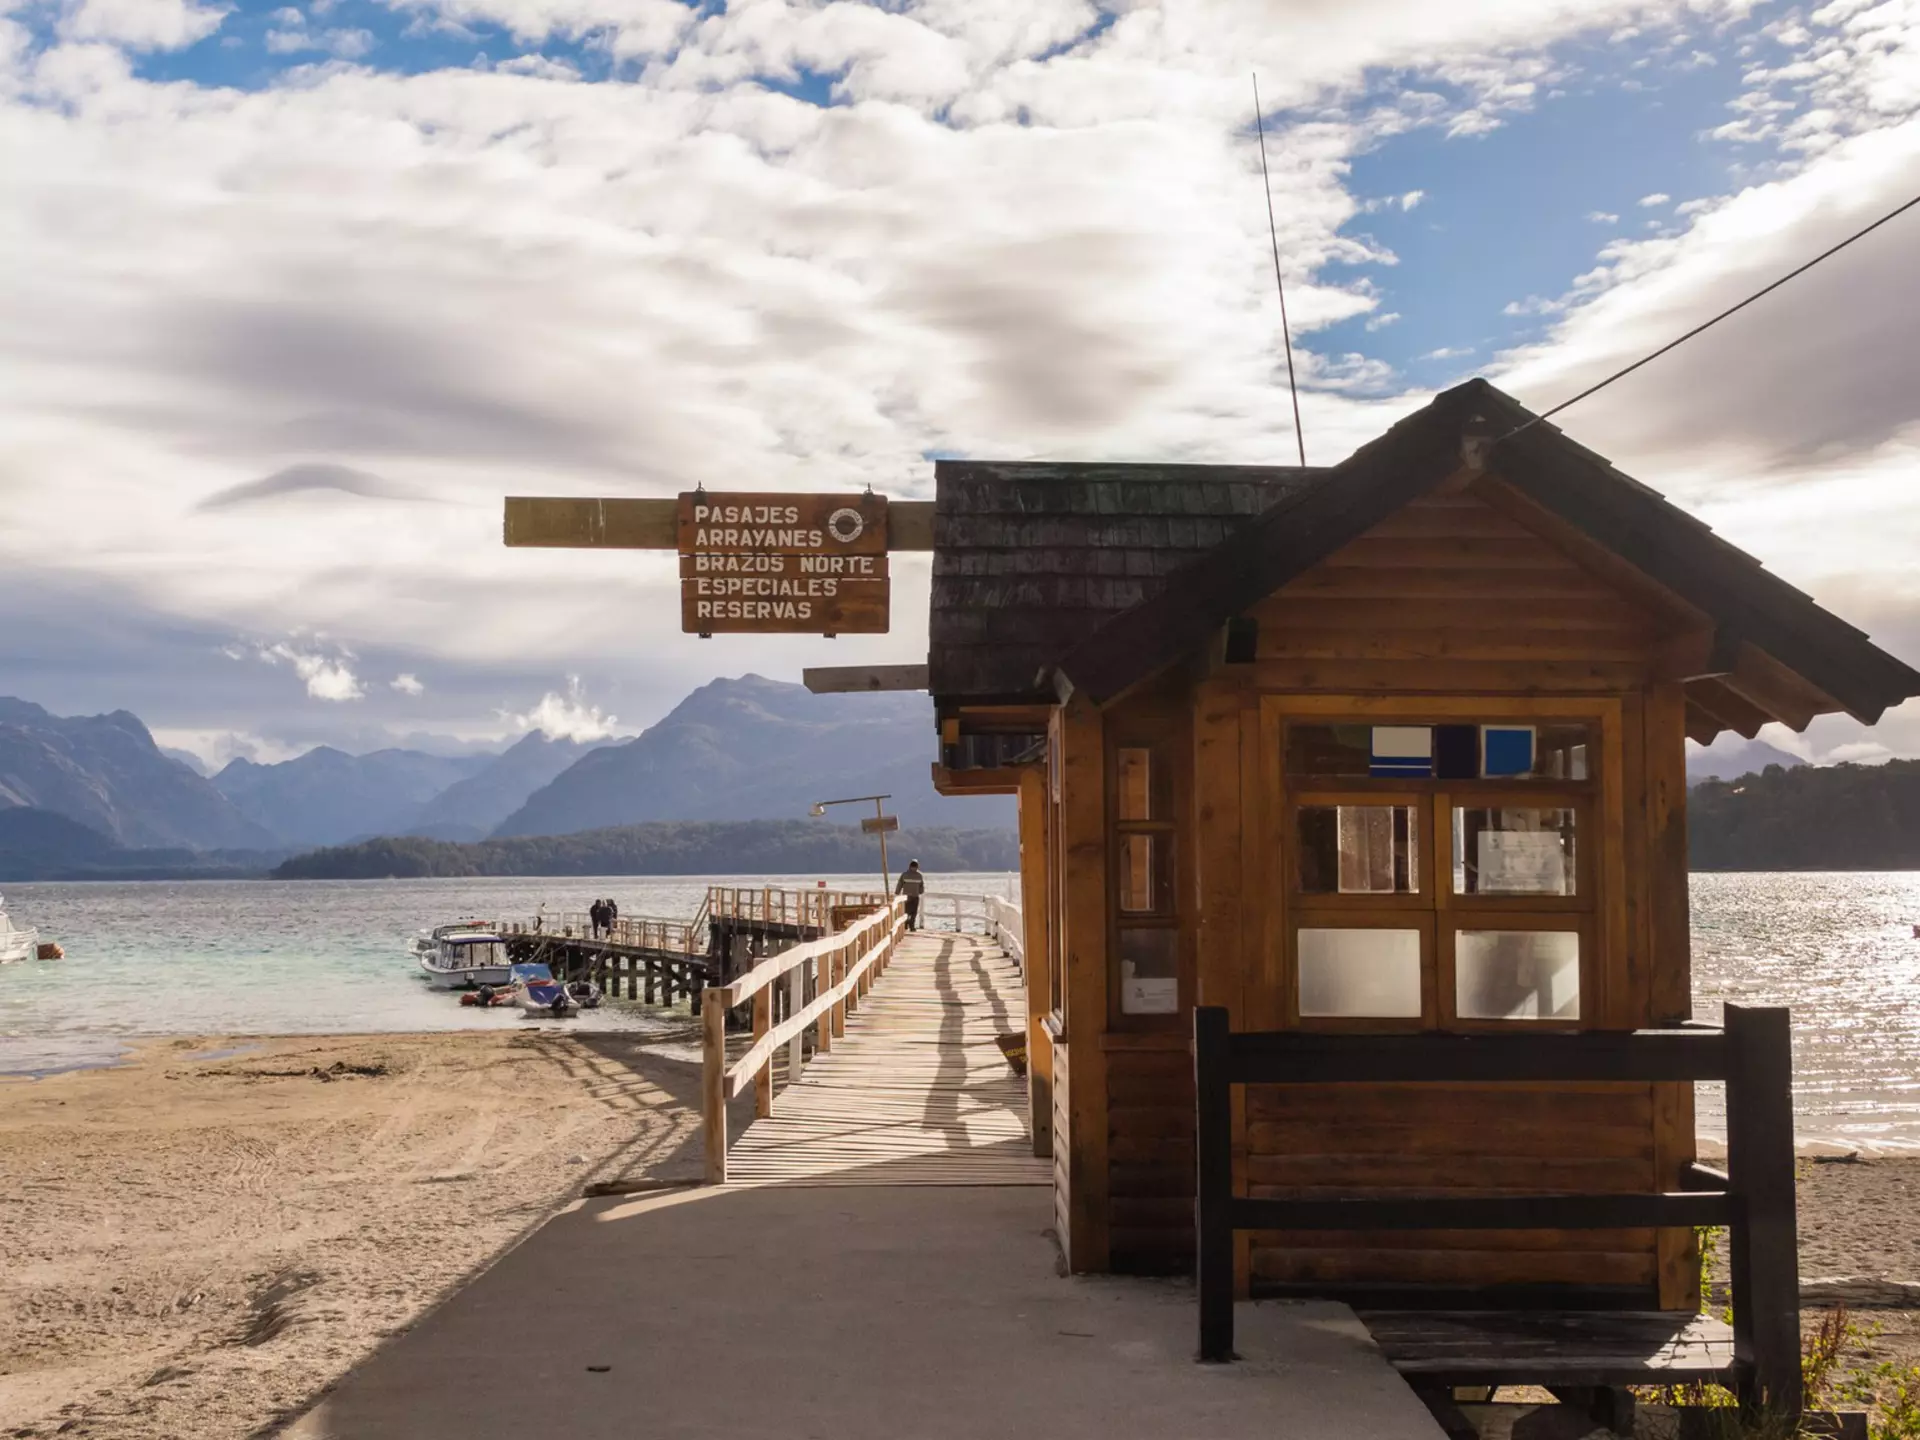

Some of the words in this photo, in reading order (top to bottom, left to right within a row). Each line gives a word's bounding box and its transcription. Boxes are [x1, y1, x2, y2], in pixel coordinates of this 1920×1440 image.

[695, 506, 798, 524] PASAJES
[695, 529, 822, 547] ARRAYANES
[696, 553, 784, 571] BRAZOS
[800, 554, 874, 573] NORTE
[697, 579, 837, 596] ESPECIALES
[697, 601, 811, 618] RESERVAS
